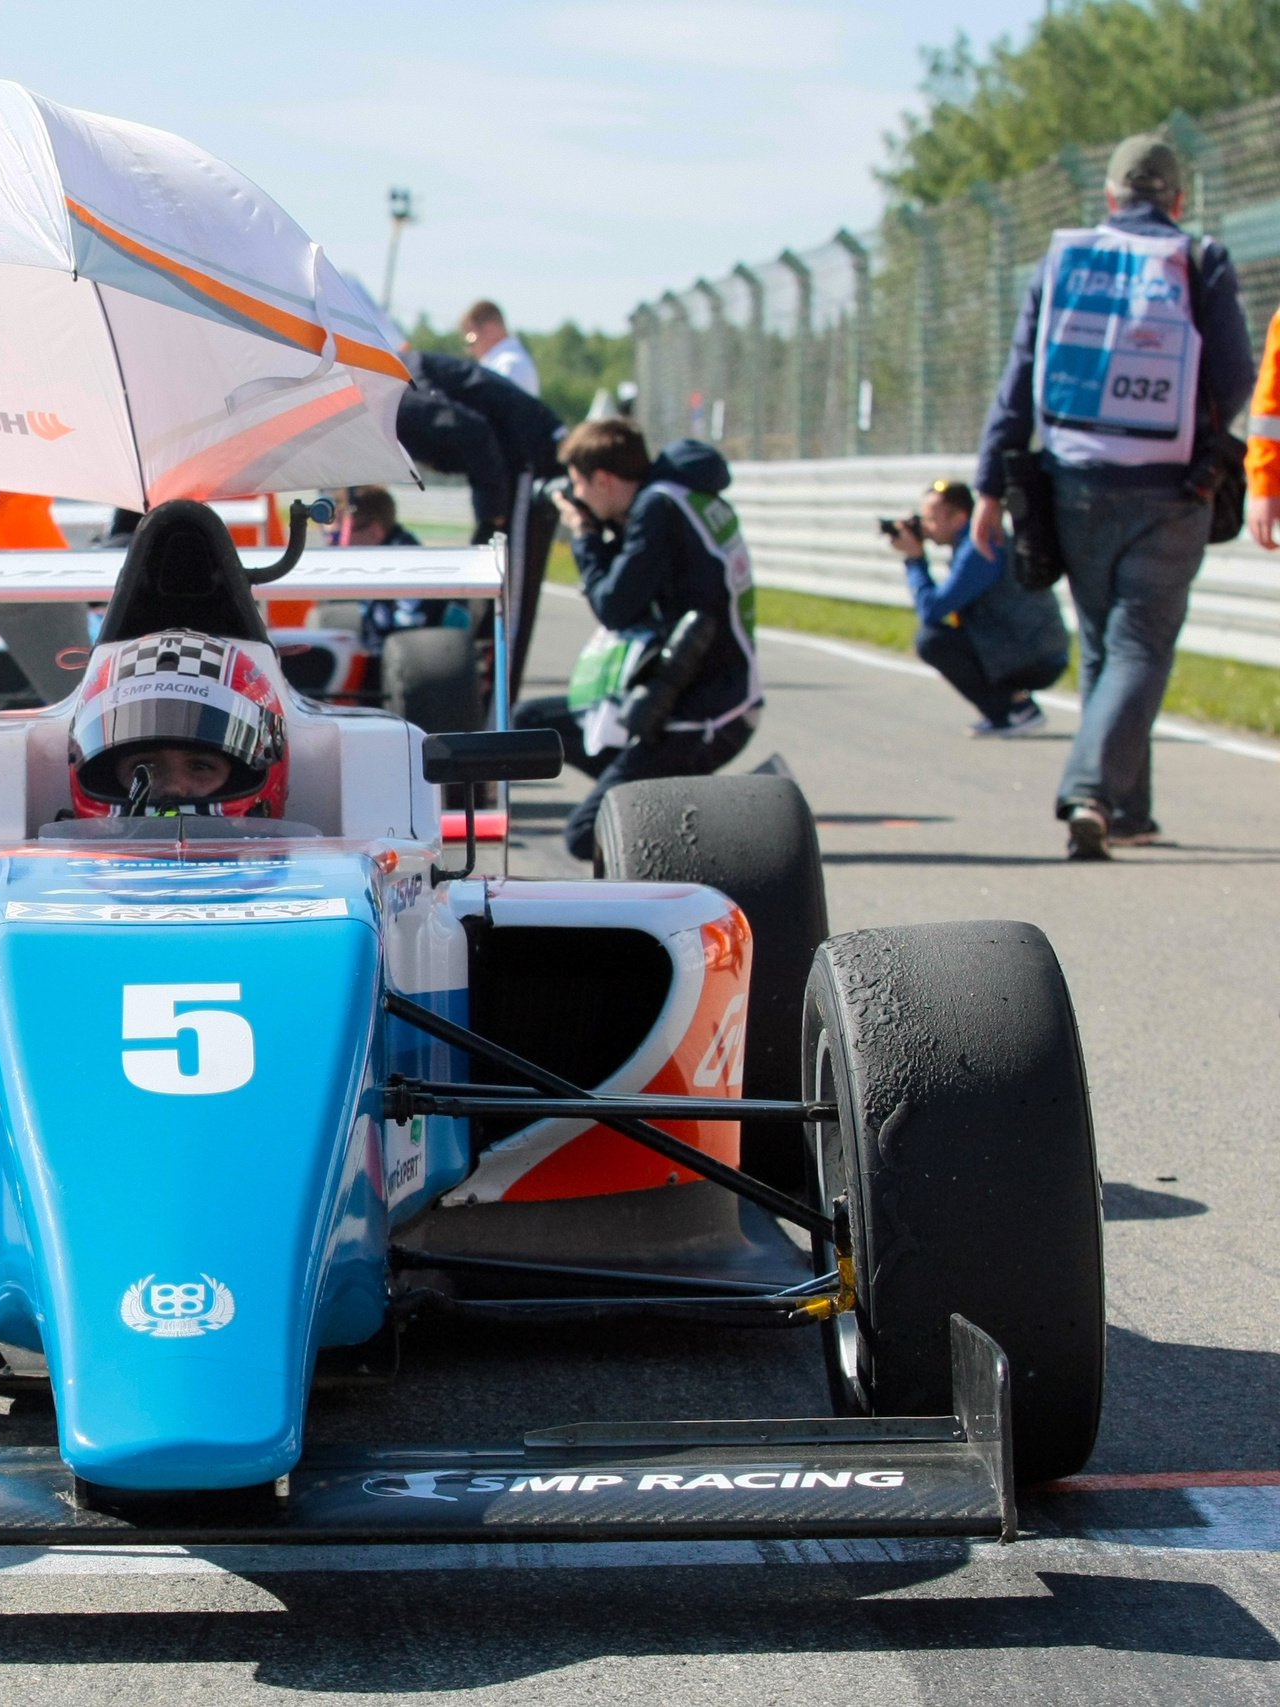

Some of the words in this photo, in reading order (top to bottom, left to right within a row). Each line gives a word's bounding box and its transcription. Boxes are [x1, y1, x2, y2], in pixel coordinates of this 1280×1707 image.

[1112, 375, 1172, 402] 032
[122, 683, 152, 698] SMP
[154, 682, 209, 698] RACING
[110, 908, 317, 920] RALLY
[111, 902, 319, 912] ACADEMY
[122, 983, 255, 1095] 5
[466, 1475, 623, 1493] SMP
[637, 1471, 905, 1491] RACING
